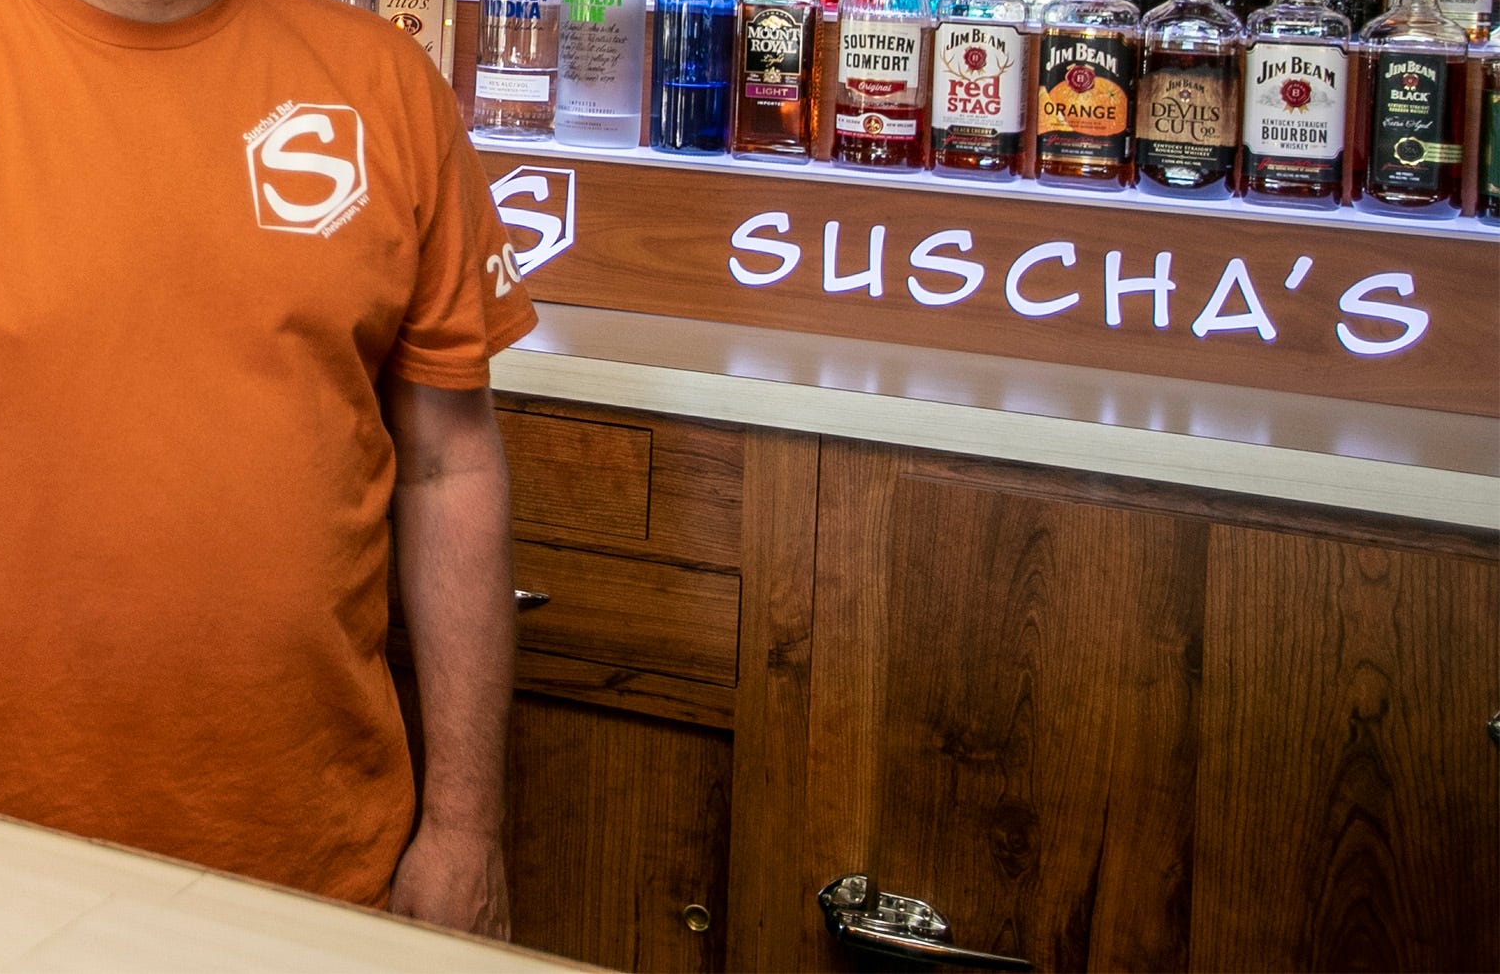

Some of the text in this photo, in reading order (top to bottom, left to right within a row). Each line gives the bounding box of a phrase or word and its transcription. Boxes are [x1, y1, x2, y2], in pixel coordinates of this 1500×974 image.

[485, 0, 541, 19] VODKA
[570, 5, 606, 22] LIME
[748, 26, 800, 41] MOUNT
[947, 28, 1006, 52] JIM BEAM
[750, 39, 797, 53] ROYAL
[844, 34, 915, 54] SOUTHERN
[846, 53, 909, 71] COMFORT
[1046, 43, 1117, 73] JIM BEAM
[1257, 57, 1336, 88] JIM BEAM
[1385, 61, 1436, 82] JIM BEAM
[756, 87, 789, 96] LIGHT
[859, 82, 892, 92] Original
[948, 75, 1000, 99] red
[1166, 79, 1205, 93] JIM BEAM
[1390, 89, 1428, 102] BLACK
[947, 97, 1001, 115] STAG
[1044, 102, 1116, 120] ORANGE
[1151, 96, 1220, 121] DEVIL'S
[1155, 118, 1215, 142] CUT 90
[1262, 118, 1295, 126] KENTUCKY
[1261, 126, 1328, 143] BOURBON
[261, 113, 356, 222] S
[728, 210, 1431, 357] SUSCHA'S
